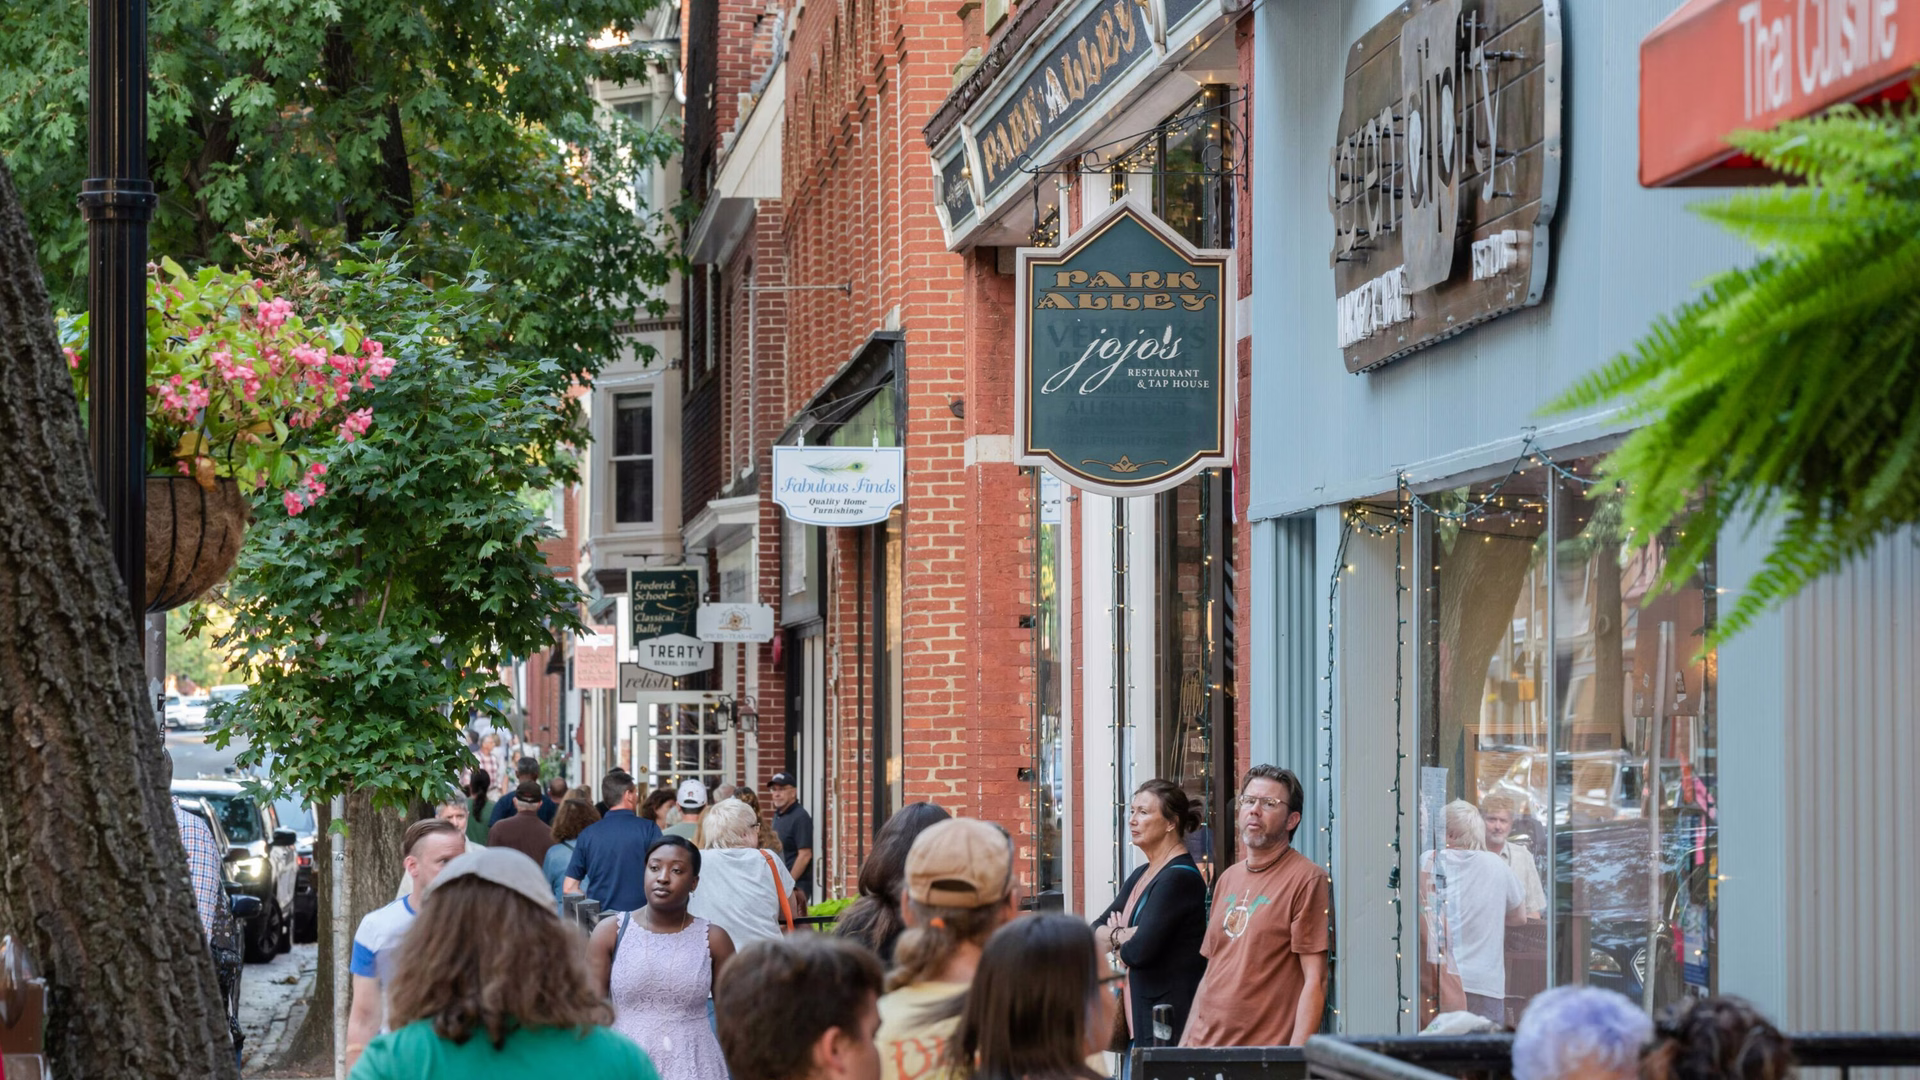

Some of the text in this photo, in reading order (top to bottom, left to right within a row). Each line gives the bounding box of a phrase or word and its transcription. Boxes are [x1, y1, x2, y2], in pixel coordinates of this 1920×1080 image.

[1738, 0, 1793, 122] Thai
[982, 0, 1137, 183] PARK ALLEY
[1054, 270, 1202, 290] PARK
[1035, 292, 1216, 311] ALLEY
[1041, 324, 1182, 395] jojo's
[1127, 368, 1200, 378] RESTAURANT
[1137, 379, 1147, 389] &
[1149, 379, 1169, 389] TAP
[1173, 379, 1209, 389] HOUSE
[780, 475, 896, 494] Fabulous Finds
[809, 498, 867, 507] Quality Home
[813, 506, 863, 515] Furnishings
[634, 580, 676, 590] Frederick
[634, 591, 668, 600] School
[634, 601, 646, 611] of
[634, 612, 675, 622] Classical
[635, 623, 662, 633] Ballet
[649, 644, 704, 659] TREATY
[625, 672, 669, 689] relish
